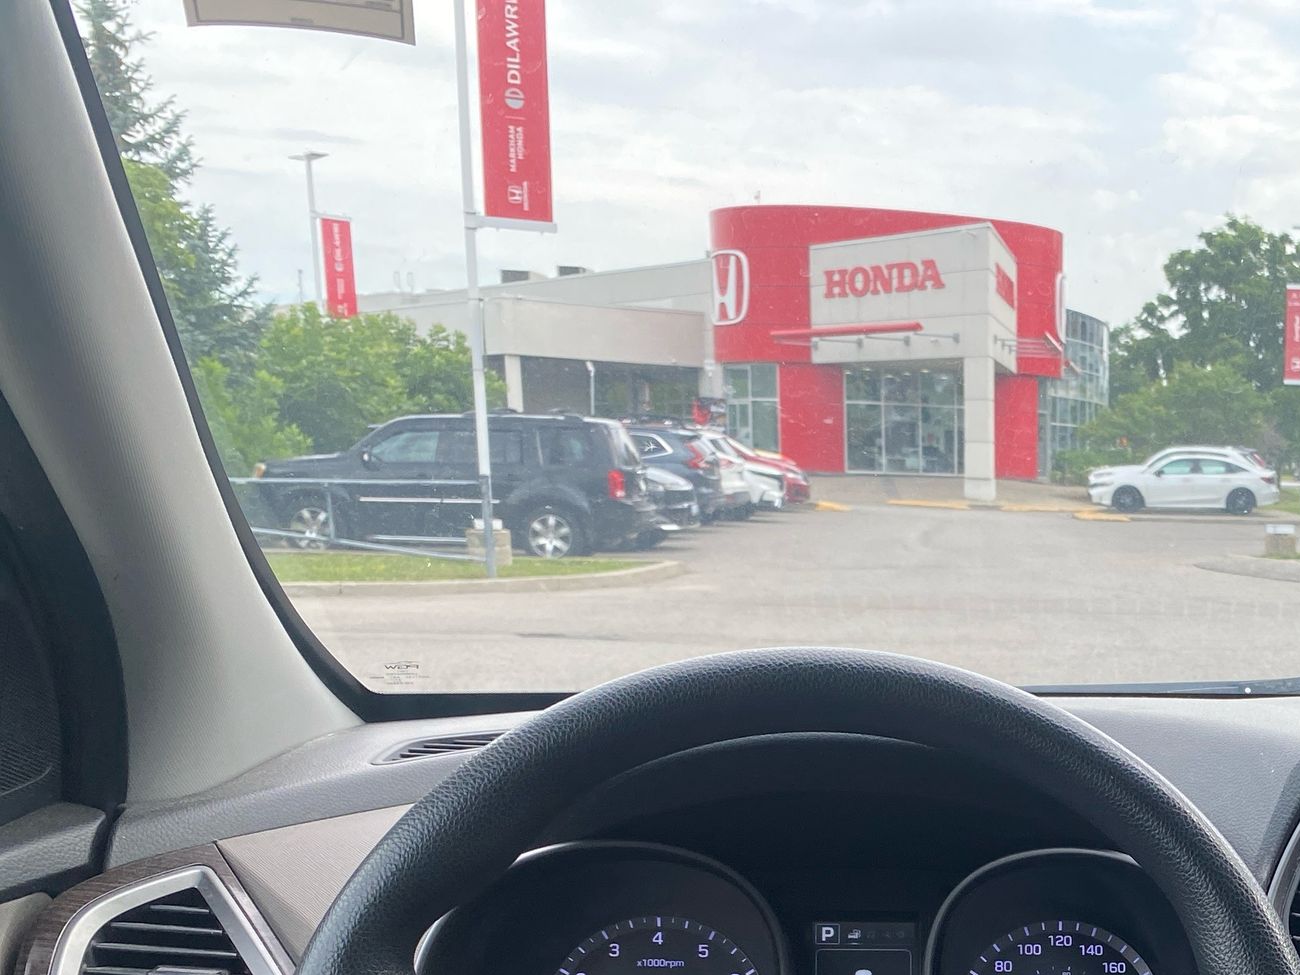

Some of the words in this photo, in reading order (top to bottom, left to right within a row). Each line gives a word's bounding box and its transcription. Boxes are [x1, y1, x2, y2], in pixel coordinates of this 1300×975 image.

[508, 125, 517, 172] MARKHAM
[516, 126, 525, 160] HONDA
[823, 259, 945, 299] HONDA
[652, 932, 664, 945] 4
[822, 927, 834, 941] P
[1048, 935, 1072, 947] 120
[609, 944, 620, 957] 3
[698, 944, 709, 958] 5
[1018, 944, 1042, 956] 100
[1079, 944, 1103, 956] 140
[636, 958, 685, 969] x1000rpm
[994, 961, 1012, 972] 80
[1103, 962, 1126, 973] 160
